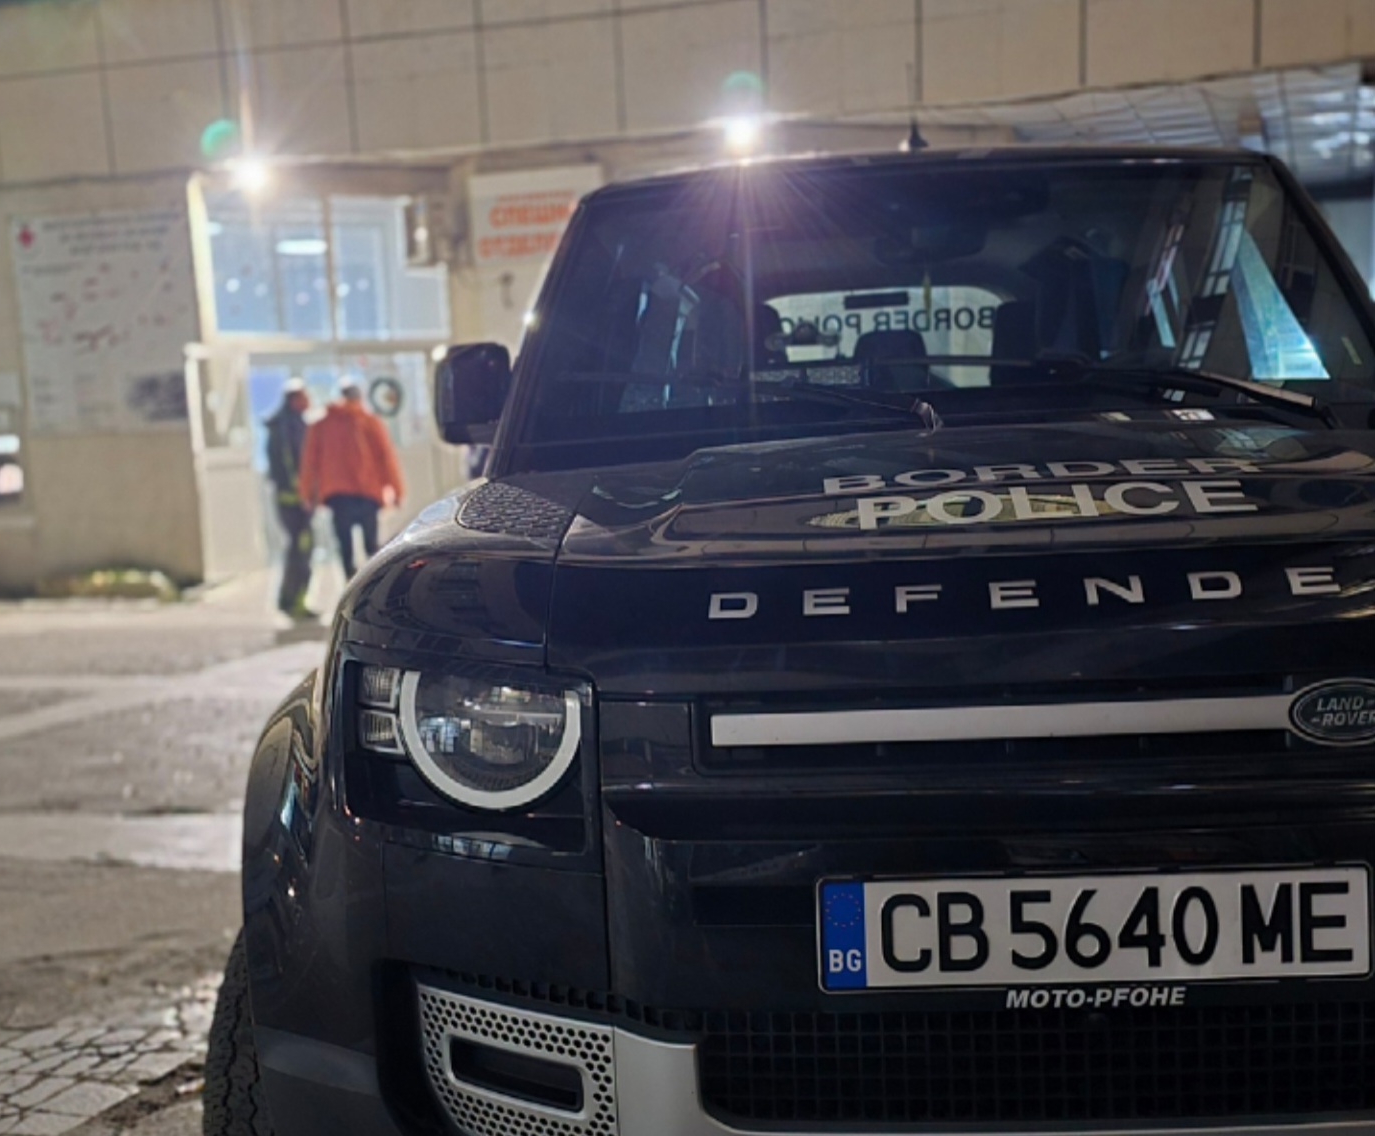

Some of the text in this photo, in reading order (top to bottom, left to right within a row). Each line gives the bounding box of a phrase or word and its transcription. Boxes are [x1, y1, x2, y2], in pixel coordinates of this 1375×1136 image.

[824, 458, 1261, 494] BORDER
[857, 480, 1259, 531] POLICE
[708, 567, 1342, 619] DEFENDE
[1317, 696, 1365, 712] LAND
[829, 949, 862, 973] BG
[1006, 987, 1187, 1008] MOTO-PFOHE
